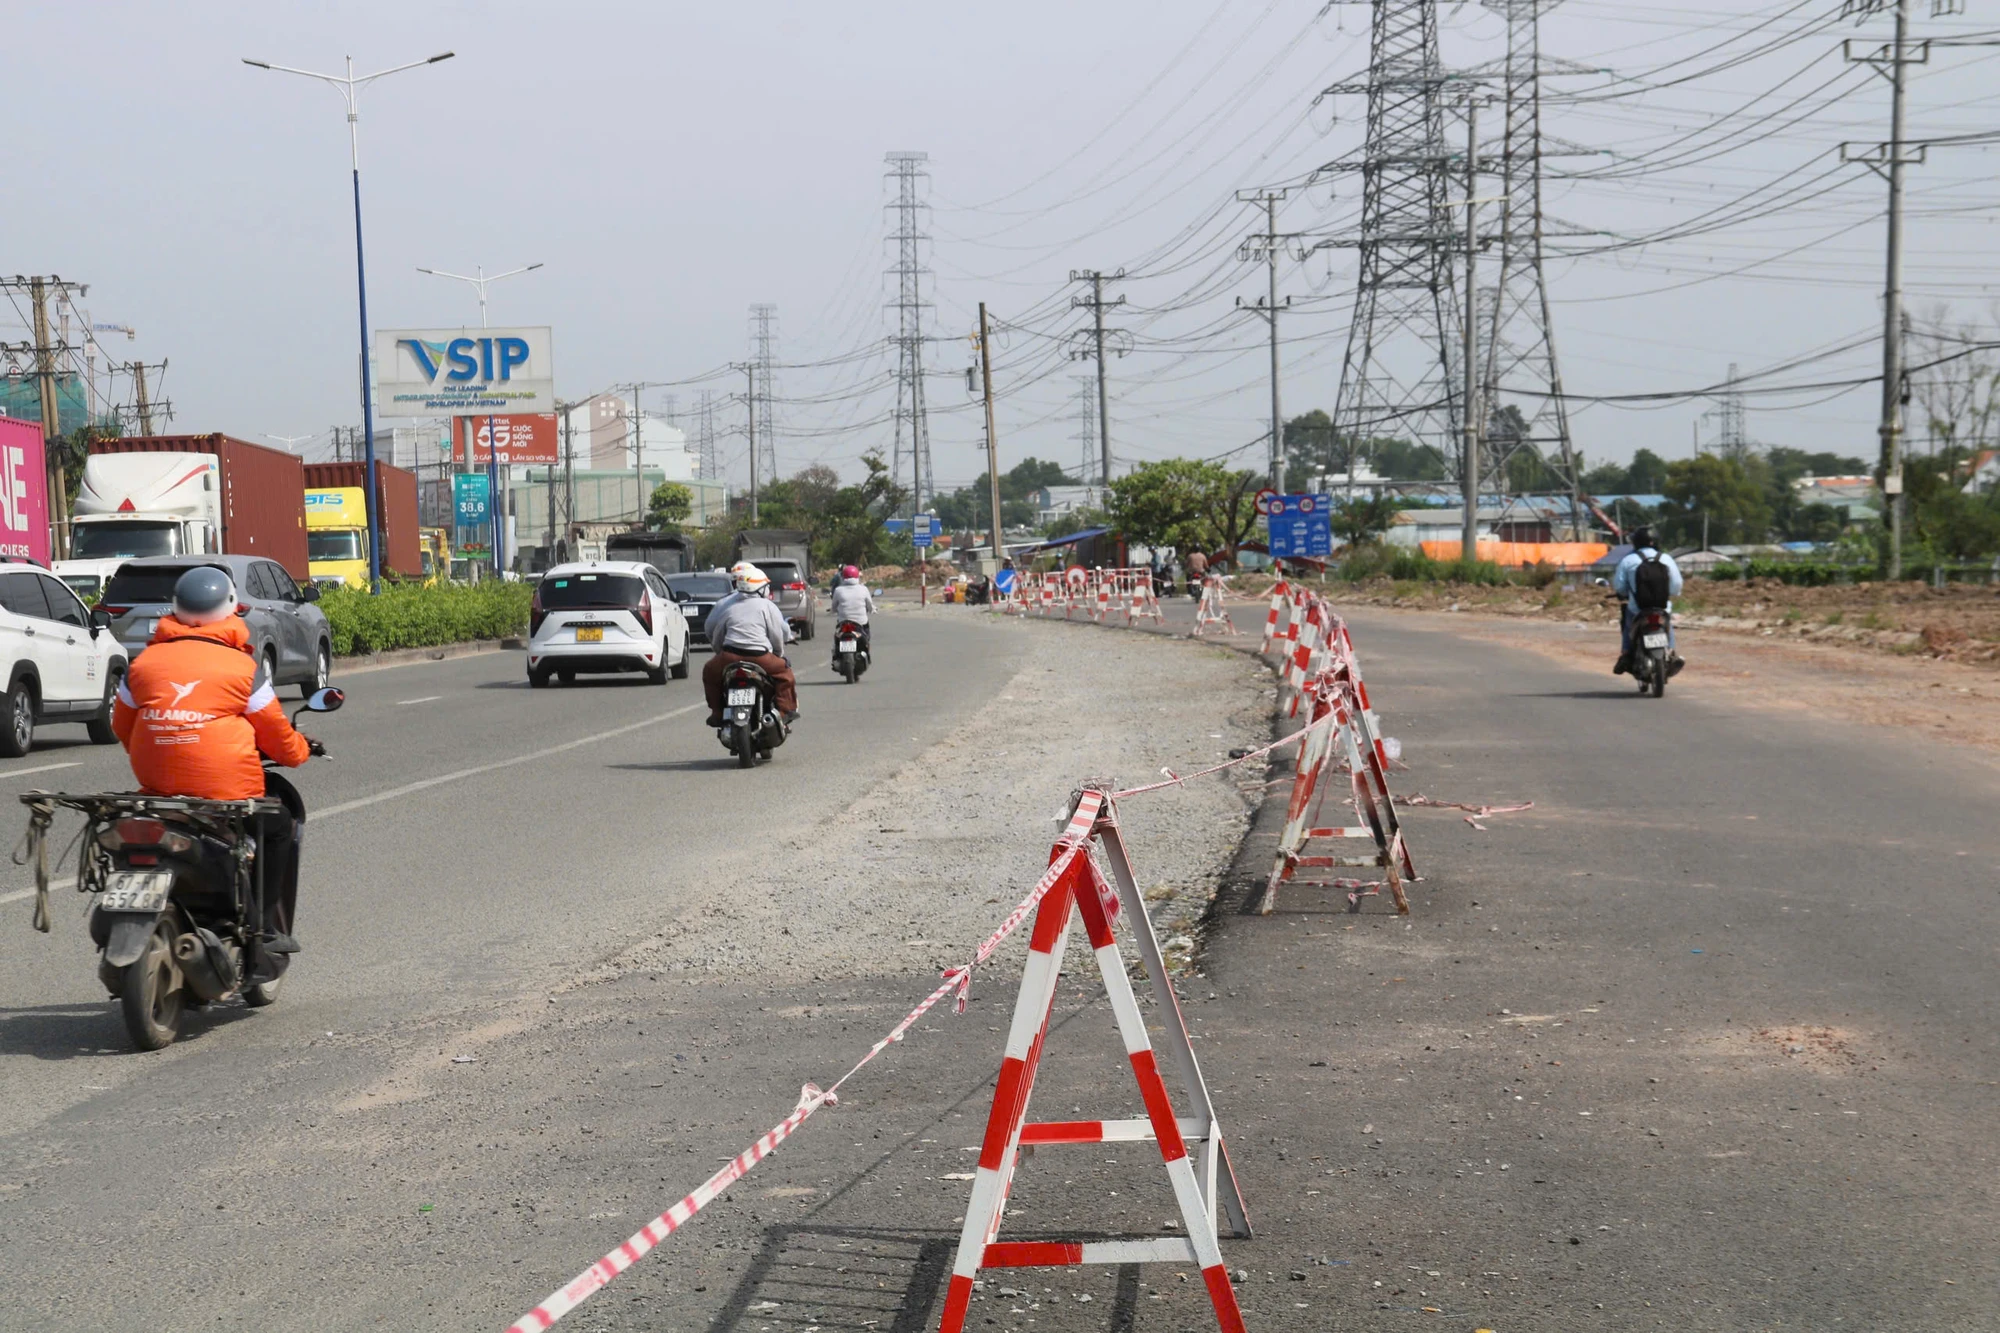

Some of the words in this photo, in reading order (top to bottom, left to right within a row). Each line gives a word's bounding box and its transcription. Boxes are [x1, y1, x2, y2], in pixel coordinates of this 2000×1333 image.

[397, 338, 530, 381] VSIP
[477, 426, 510, 447] 5G
[460, 502, 484, 513] 38.6
